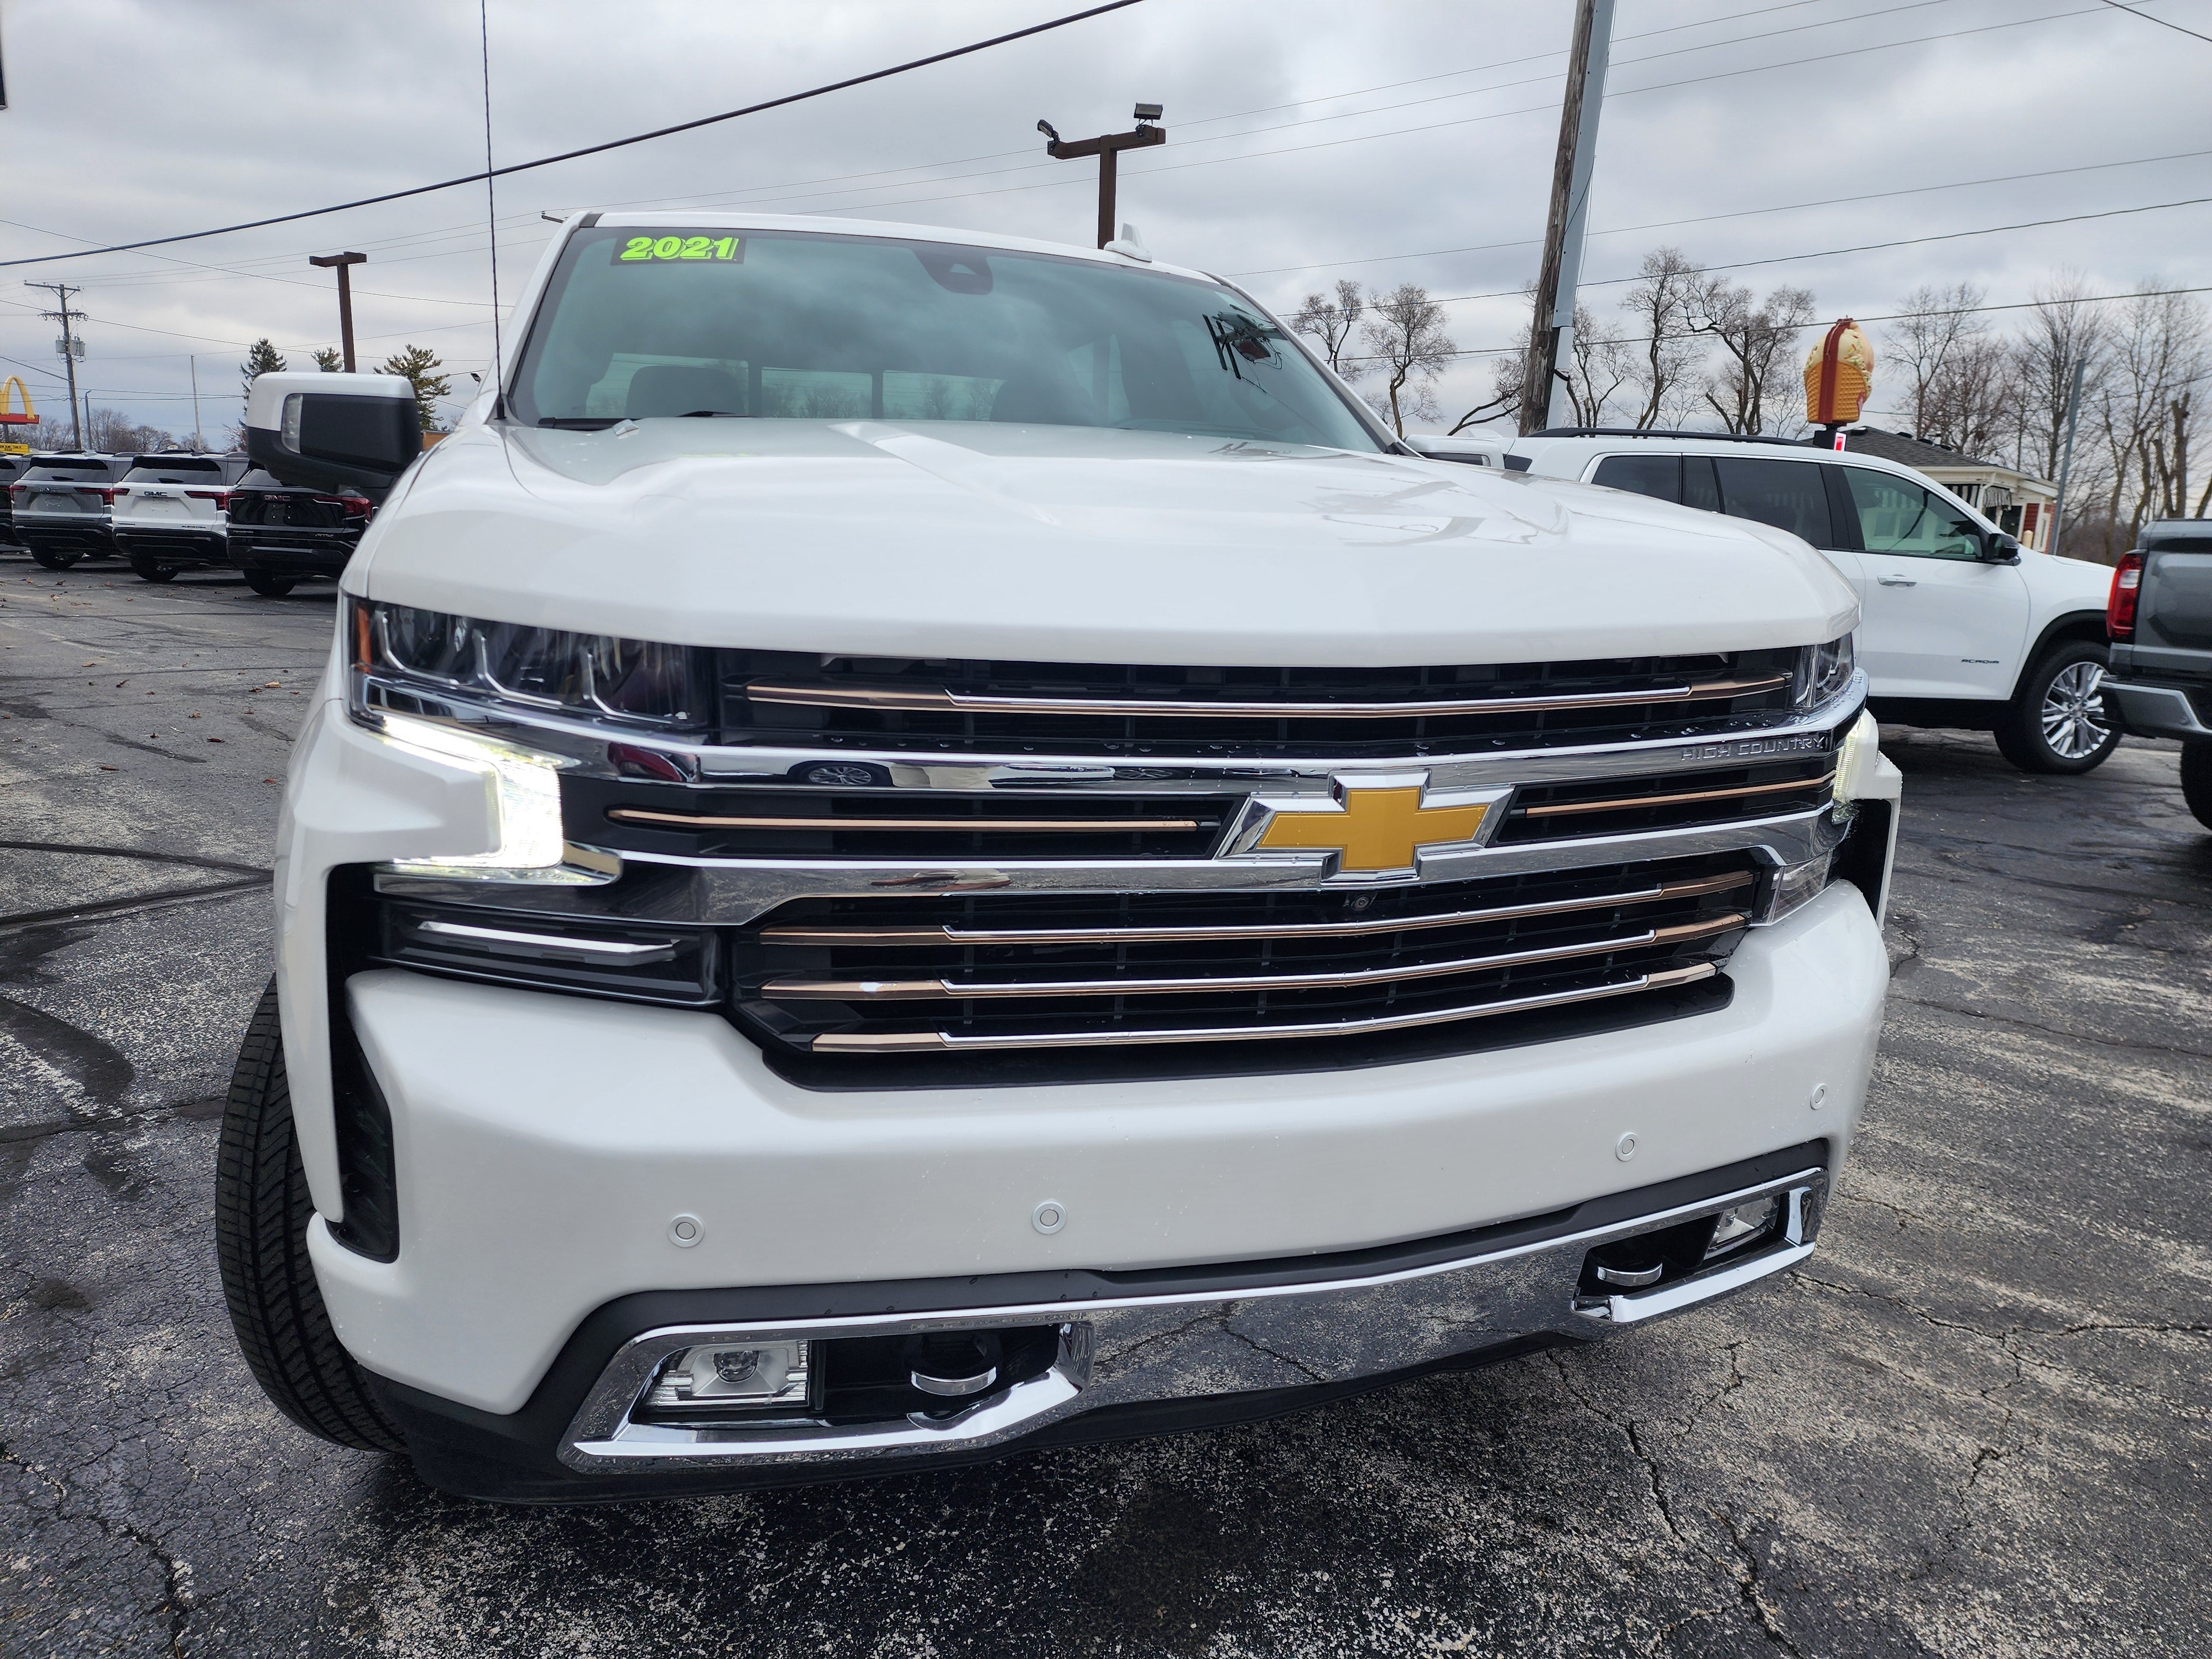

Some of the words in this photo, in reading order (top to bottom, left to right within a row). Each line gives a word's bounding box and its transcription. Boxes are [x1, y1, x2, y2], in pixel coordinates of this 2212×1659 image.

[620, 236, 739, 260] 2021
[1681, 744, 1731, 761] HIGH
[1738, 736, 1825, 756] COUNTRY
